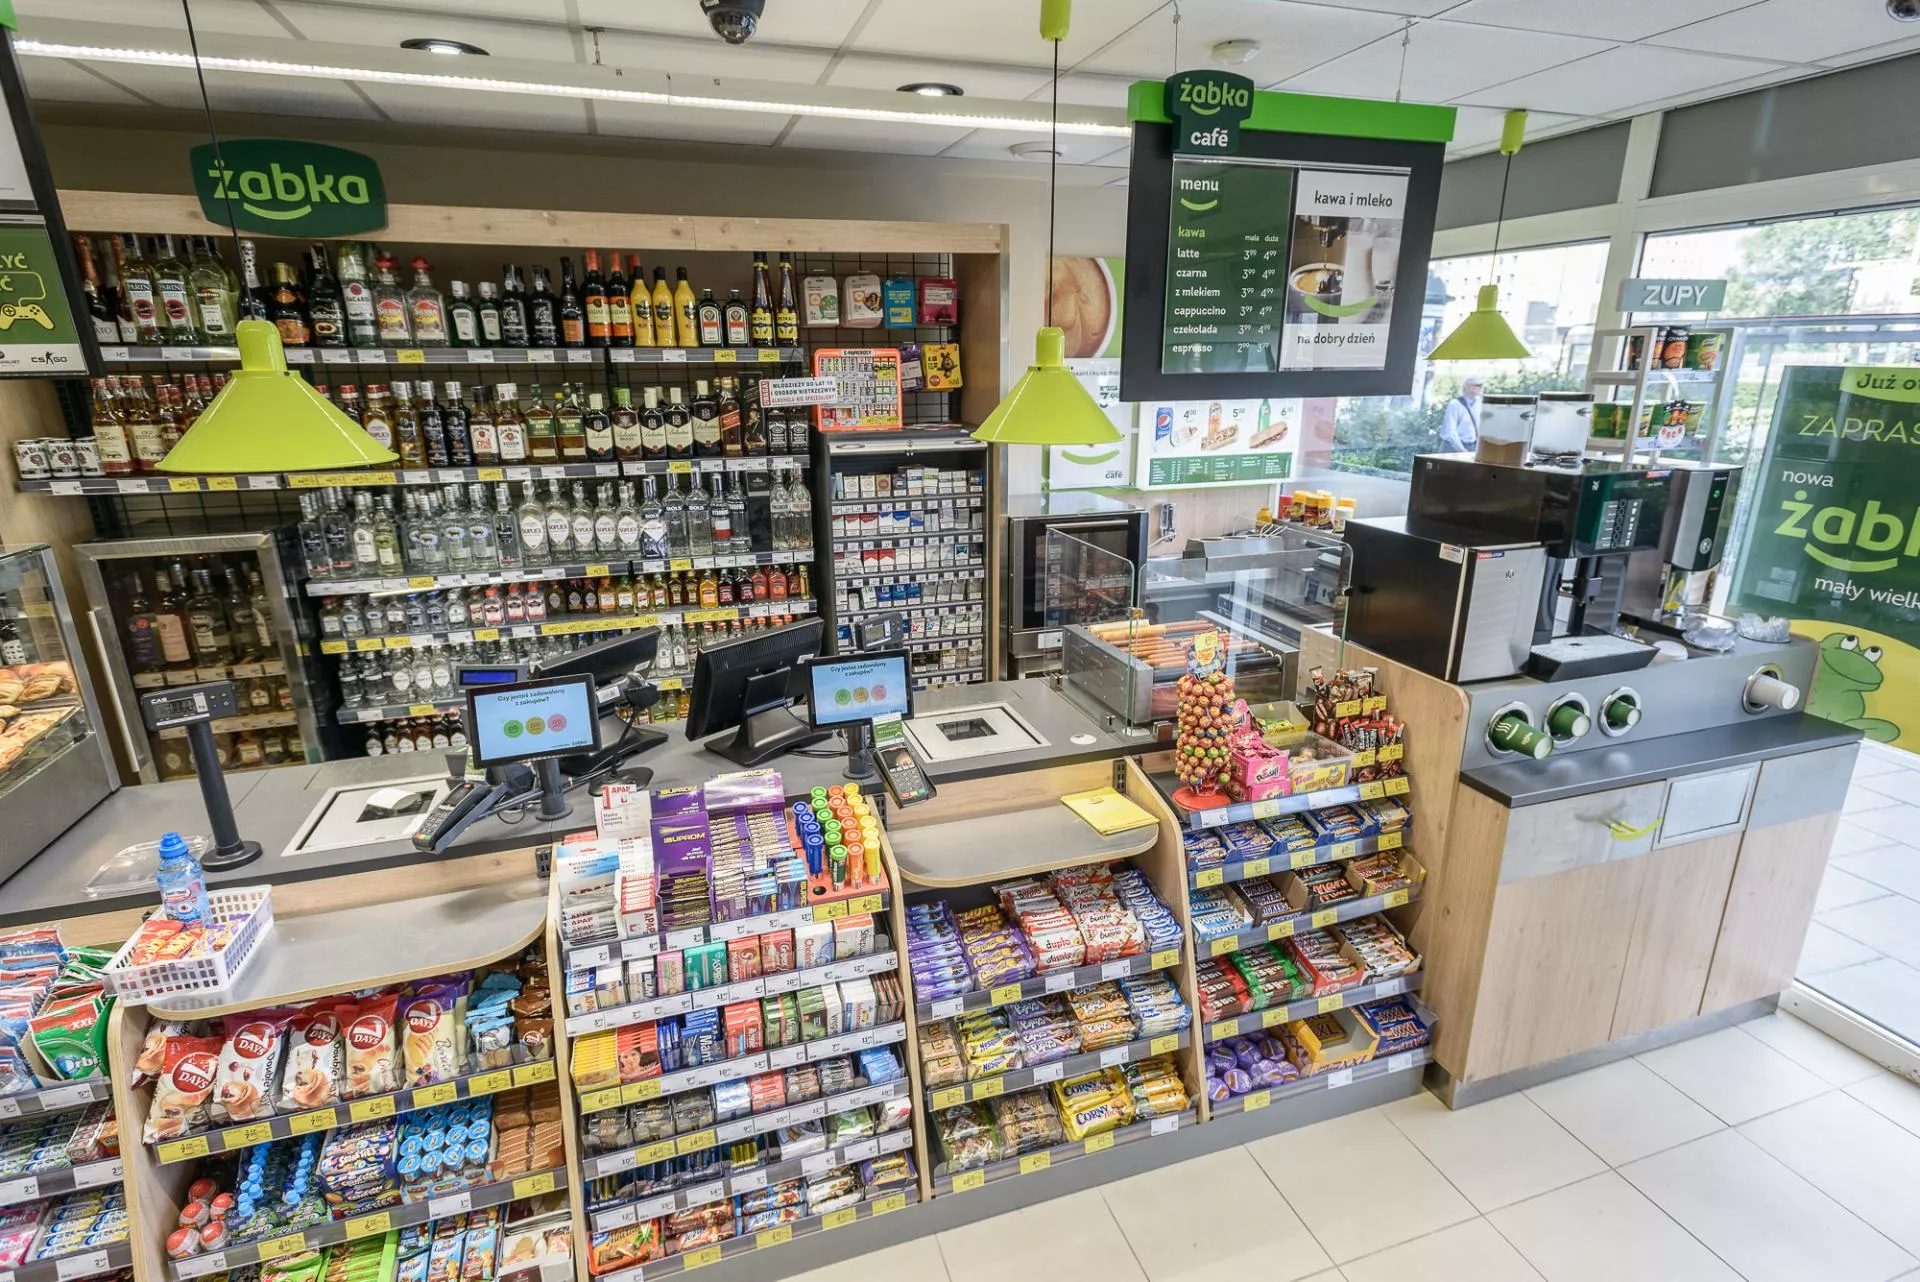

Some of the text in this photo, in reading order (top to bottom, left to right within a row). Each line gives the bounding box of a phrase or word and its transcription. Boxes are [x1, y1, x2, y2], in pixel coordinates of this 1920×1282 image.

[1180, 78, 1249, 107] żabka
[1190, 127, 1229, 149] café
[208, 159, 370, 205] żabka
[1180, 178, 1219, 191] menu
[1314, 190, 1394, 207] kawa i mleko
[1178, 226, 1206, 238] kawa
[1177, 248, 1200, 258] latte
[1176, 269, 1207, 278] czarna
[1175, 289, 1181, 297] z
[1182, 286, 1221, 297] mlekiem
[1643, 285, 1708, 305] ZUPY
[1174, 306, 1226, 318] cappuccino
[1173, 324, 1218, 335] czekolada
[1297, 332, 1375, 347] na dobry dzień
[1172, 345, 1213, 355] espresso
[1856, 373, 1897, 390] Już
[1105, 470, 1123, 479] café
[1782, 469, 1834, 487] nowa
[1815, 577, 1864, 601] mały
[151, 696, 167, 704] CAS
[611, 786, 631, 794] APAP
[664, 833, 706, 843] IBUPROM
[1090, 913, 1112, 922] bueno
[1100, 929, 1122, 939] bueno
[354, 1034, 381, 1045] DAYS
[239, 1039, 264, 1055] DAYS
[179, 1072, 209, 1089] DAYS
[1063, 1080, 1097, 1096] CORNY
[1076, 1104, 1108, 1125] CORNY
